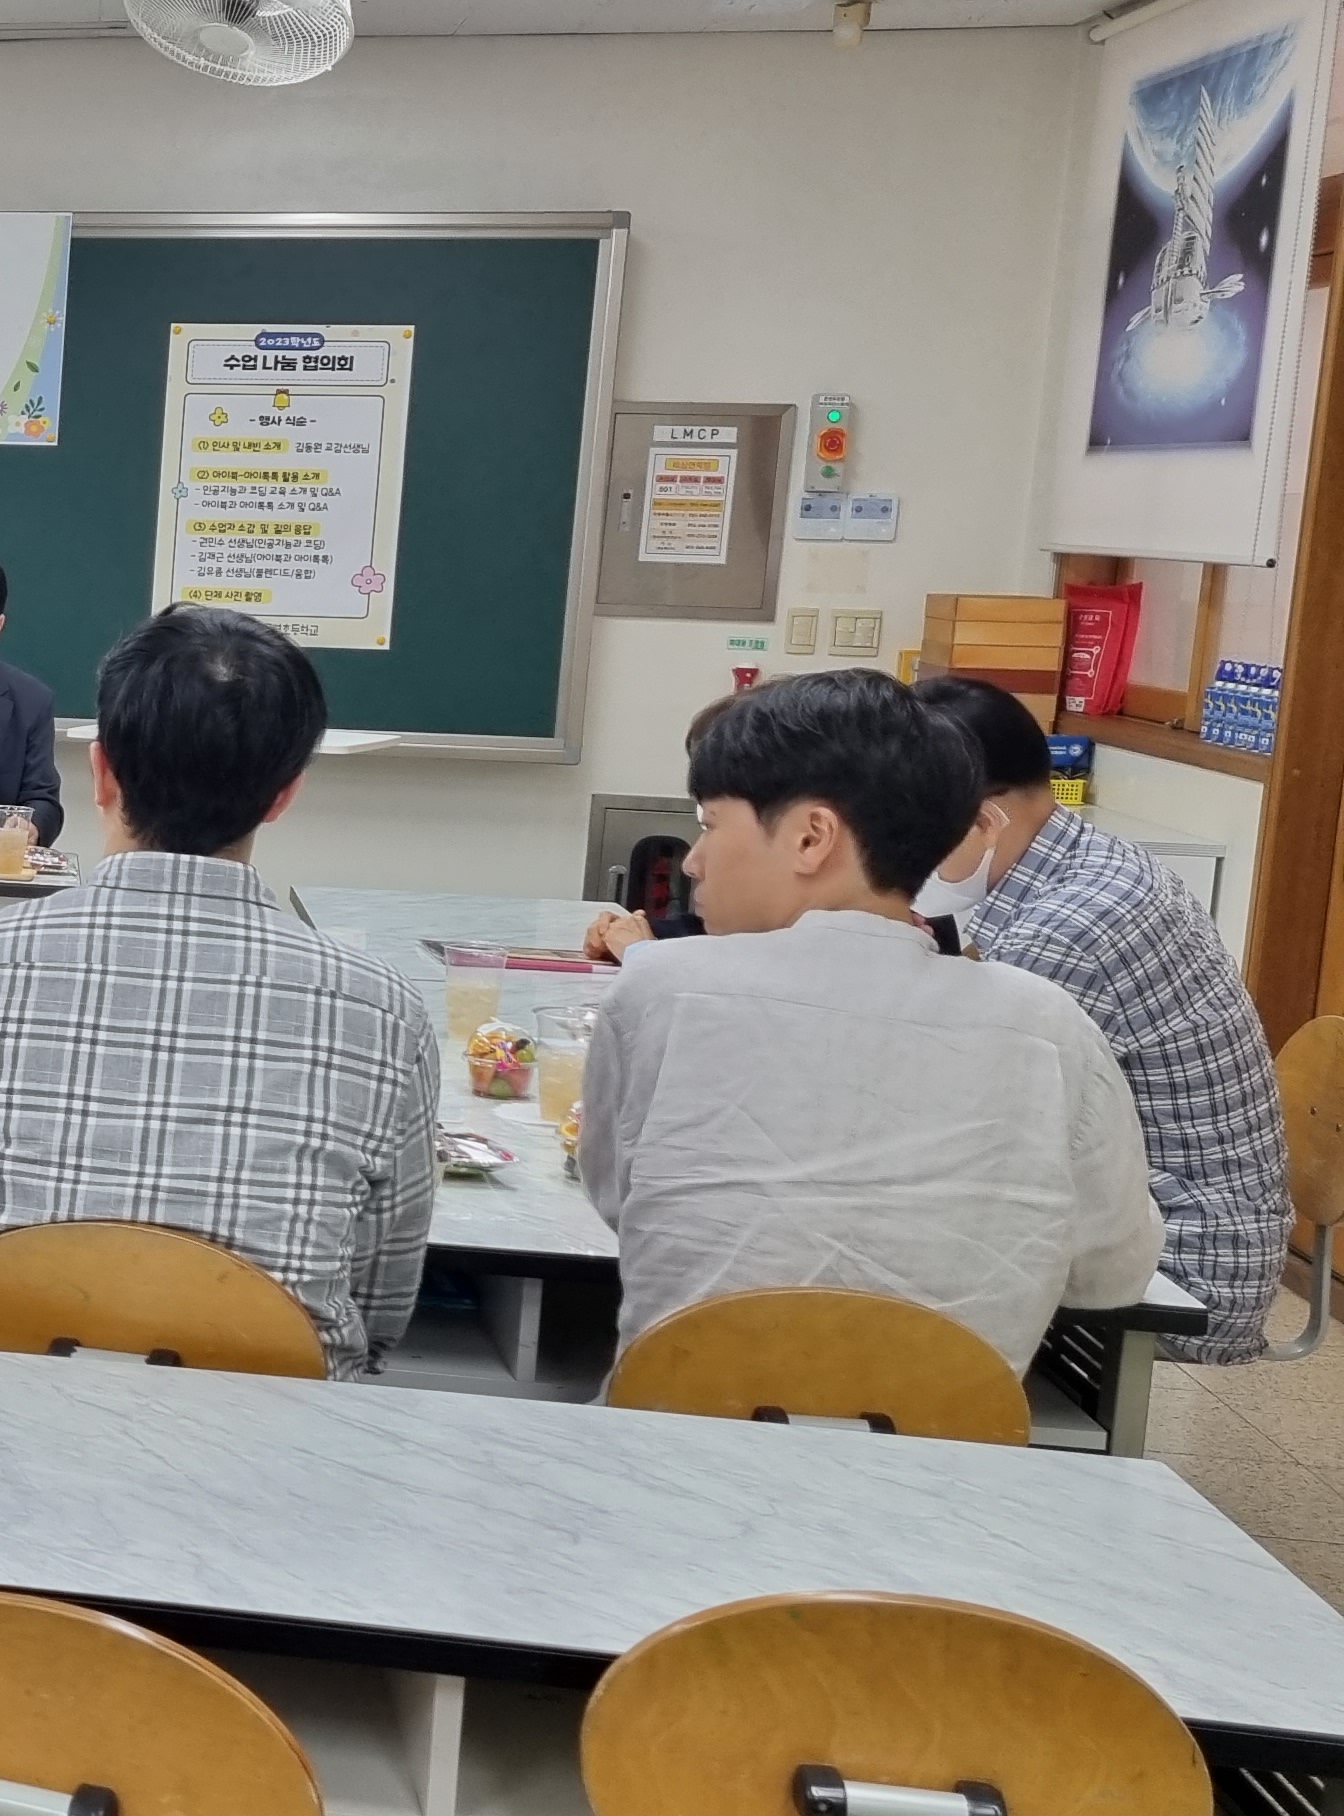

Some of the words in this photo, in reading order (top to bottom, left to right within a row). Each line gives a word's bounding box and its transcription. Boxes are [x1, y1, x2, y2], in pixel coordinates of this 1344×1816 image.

[259, 336, 321, 348] 2023학년도
[223, 354, 258, 371] 수업
[262, 354, 298, 371] 나눔
[302, 355, 355, 372] 협의회
[258, 415, 282, 426] 행사
[285, 415, 307, 427] 식순
[670, 428, 720, 440] LMCP
[198, 440, 210, 450] (1)
[212, 441, 230, 452] 인사
[243, 441, 261, 452] 내빈
[263, 441, 282, 450] 소개
[324, 442, 370, 454] 교감선생님
[196, 470, 210, 480] (2)
[302, 472, 321, 481] 소개
[203, 485, 247, 496] 인공지능과
[289, 486, 308, 495] 소개
[320, 487, 342, 497] Q&A
[277, 502, 295, 510] 소개
[308, 502, 329, 511] Q&A
[193, 522, 207, 532] (3)
[208, 522, 236, 533] 수업자
[237, 523, 256, 534] 소감
[273, 523, 292, 535] 질의
[294, 524, 313, 535] 응답
[189, 590, 202, 600] (4)
[204, 590, 223, 601] 단체
[224, 591, 243, 602] 사진
[244, 591, 263, 603] 촬영
